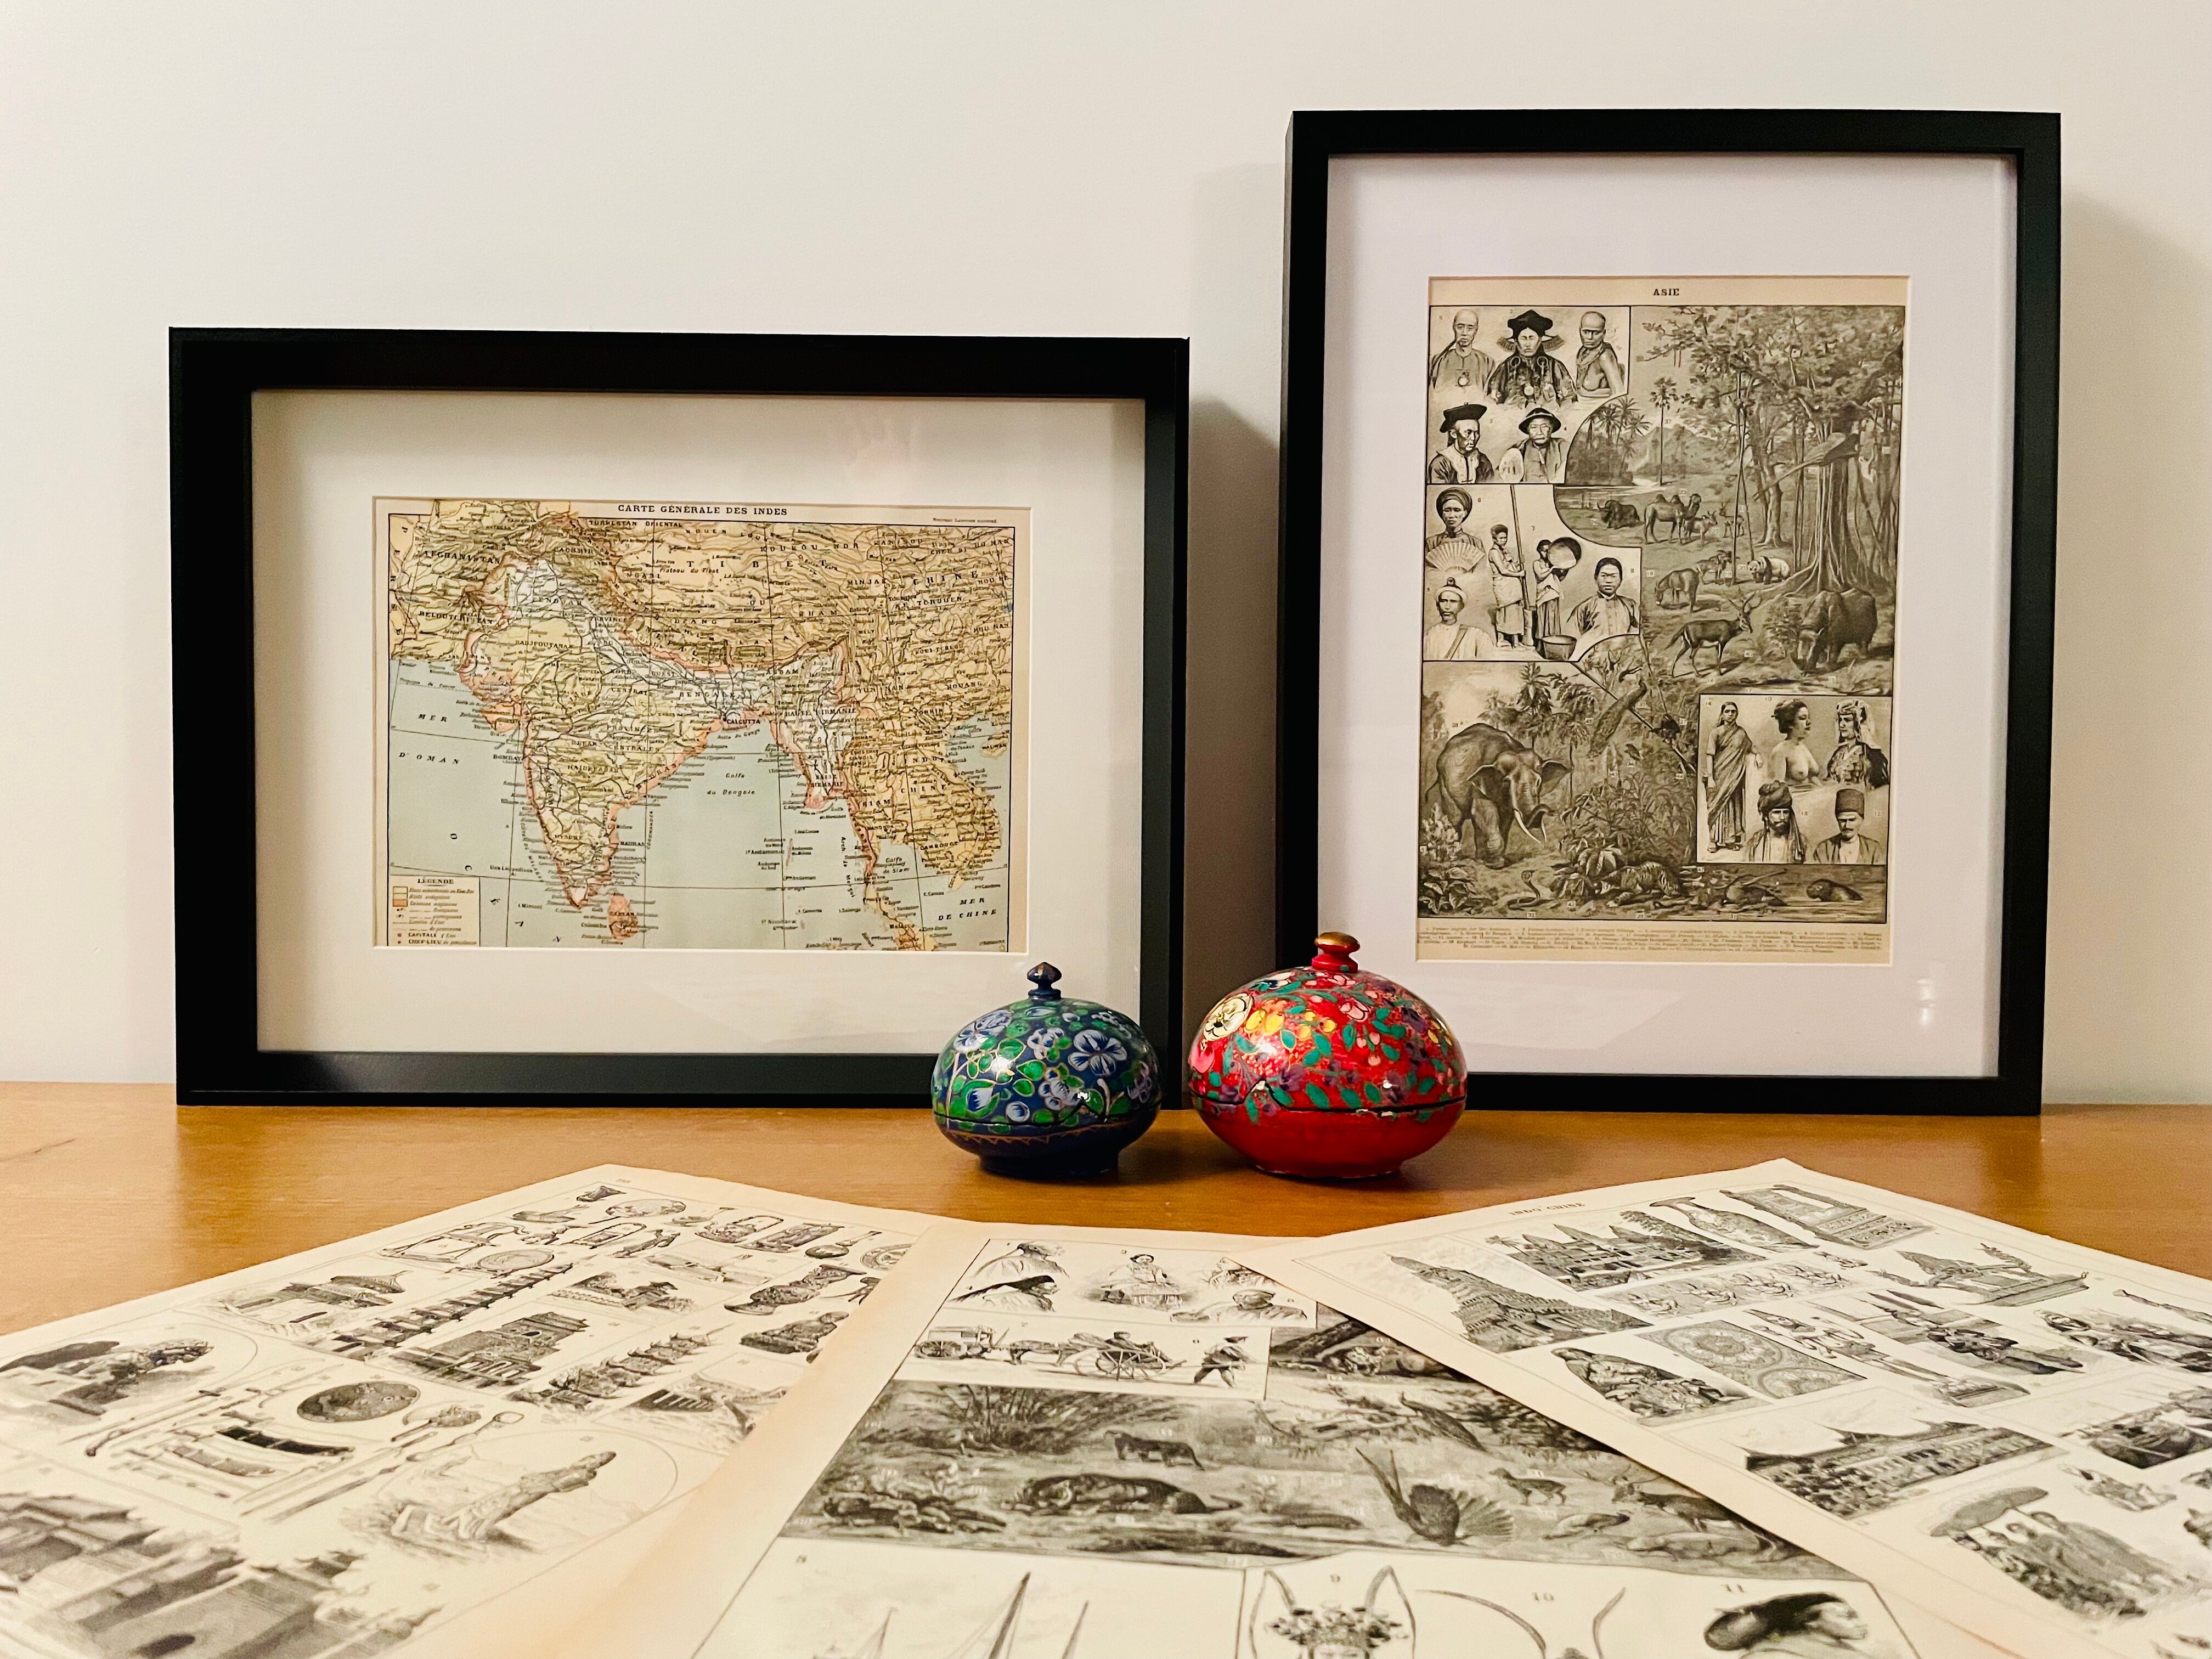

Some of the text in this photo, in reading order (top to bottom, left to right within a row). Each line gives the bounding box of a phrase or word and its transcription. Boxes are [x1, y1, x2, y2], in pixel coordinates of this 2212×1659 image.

[661, 504, 720, 514] GÉNÉRALE
[753, 507, 787, 516] INDES
[418, 714, 447, 722] MER
[416, 754, 460, 765] OMAN
[959, 909, 997, 918] CHINE
[1531, 1592, 1555, 1602] 10
